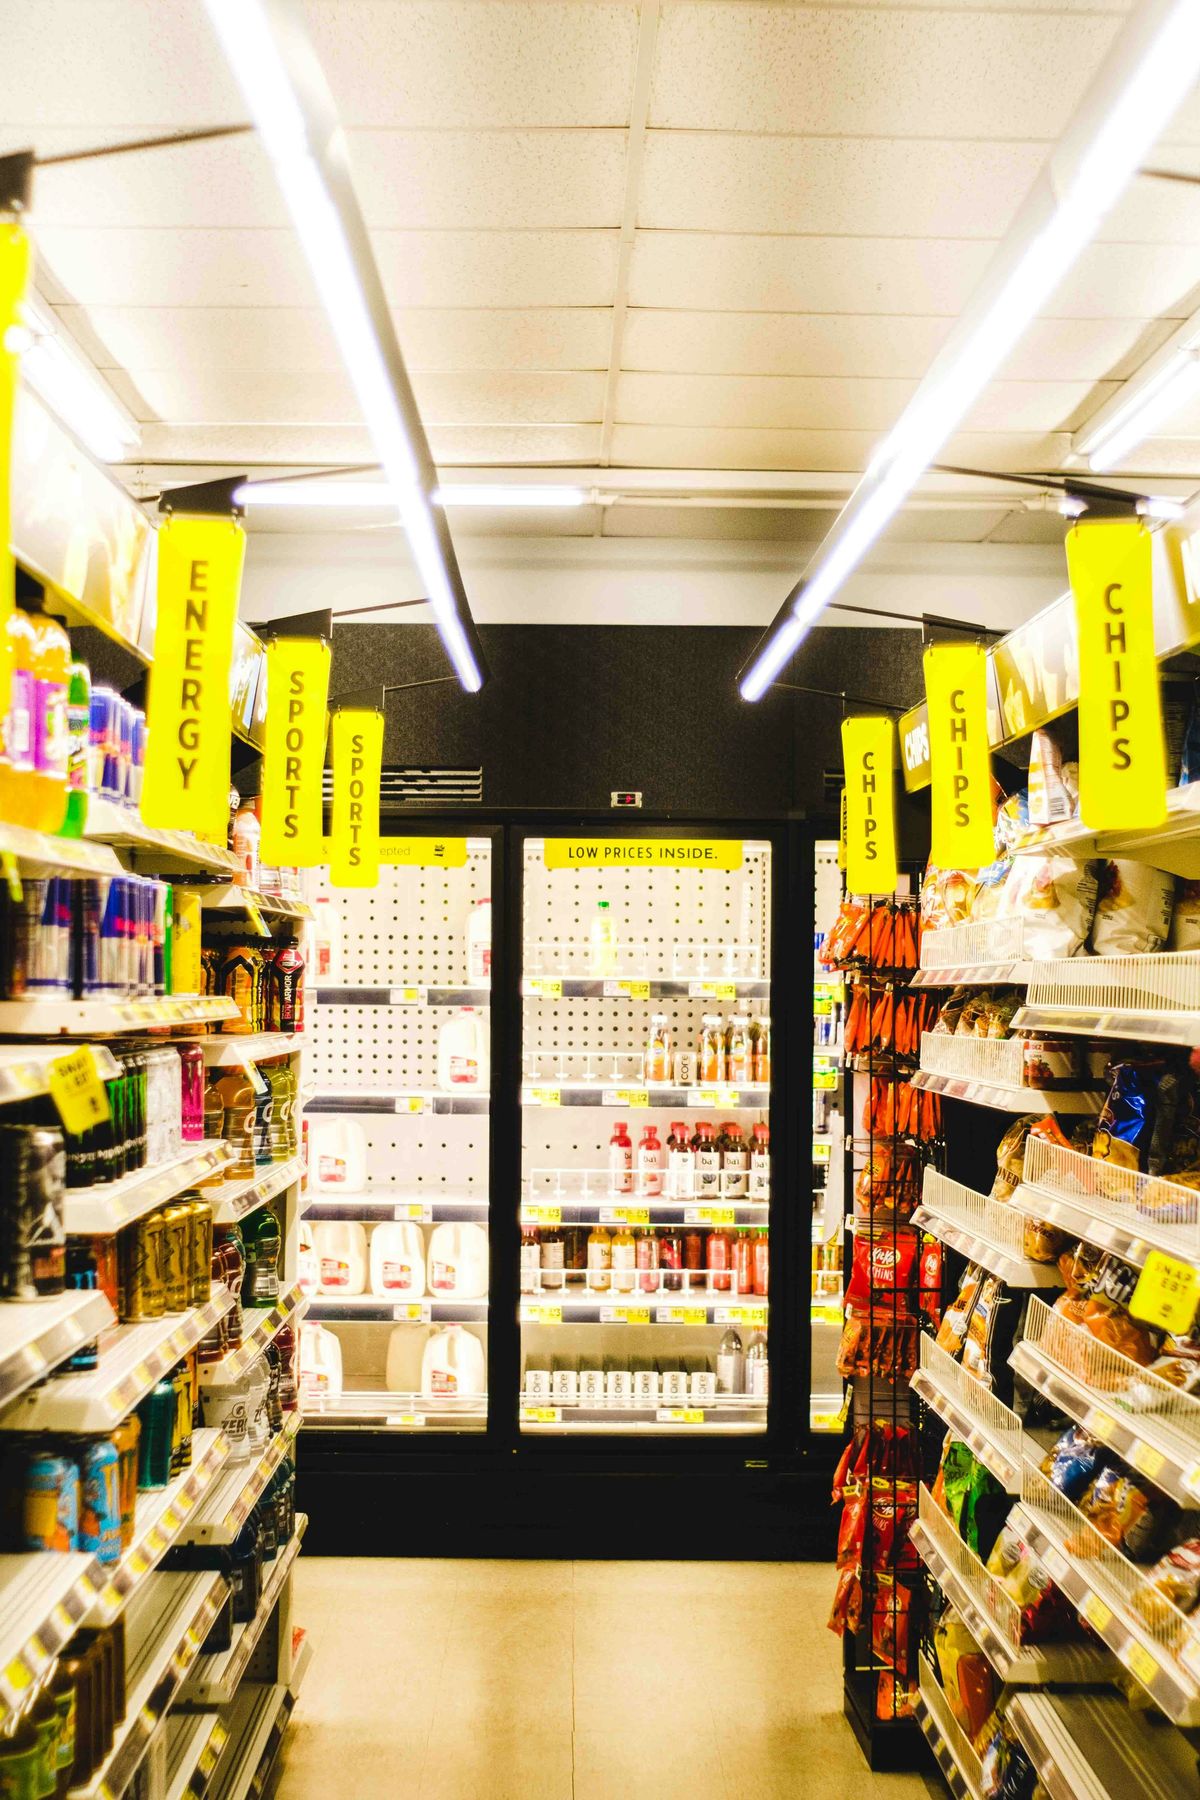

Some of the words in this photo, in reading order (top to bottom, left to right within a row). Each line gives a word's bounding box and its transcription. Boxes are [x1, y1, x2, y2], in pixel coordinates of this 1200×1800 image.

[177, 559, 210, 791] ENERGY
[1102, 582, 1133, 771] CHIPS
[283, 670, 305, 840] SPORTS
[904, 722, 930, 772] CHIPS
[949, 689, 971, 828] CHIPS
[348, 734, 366, 867] SPORTS
[861, 751, 878, 862] CHIPS
[379, 846, 411, 857] epted
[568, 846, 599, 860] LOW
[604, 846, 653, 860] PRICES
[659, 847, 719, 860] INSIDE.
[681, 1054, 690, 1081] core
[624, 1152, 632, 1161] ba
[600, 1247, 611, 1256] ba
[872, 1247, 898, 1266] KitKa
